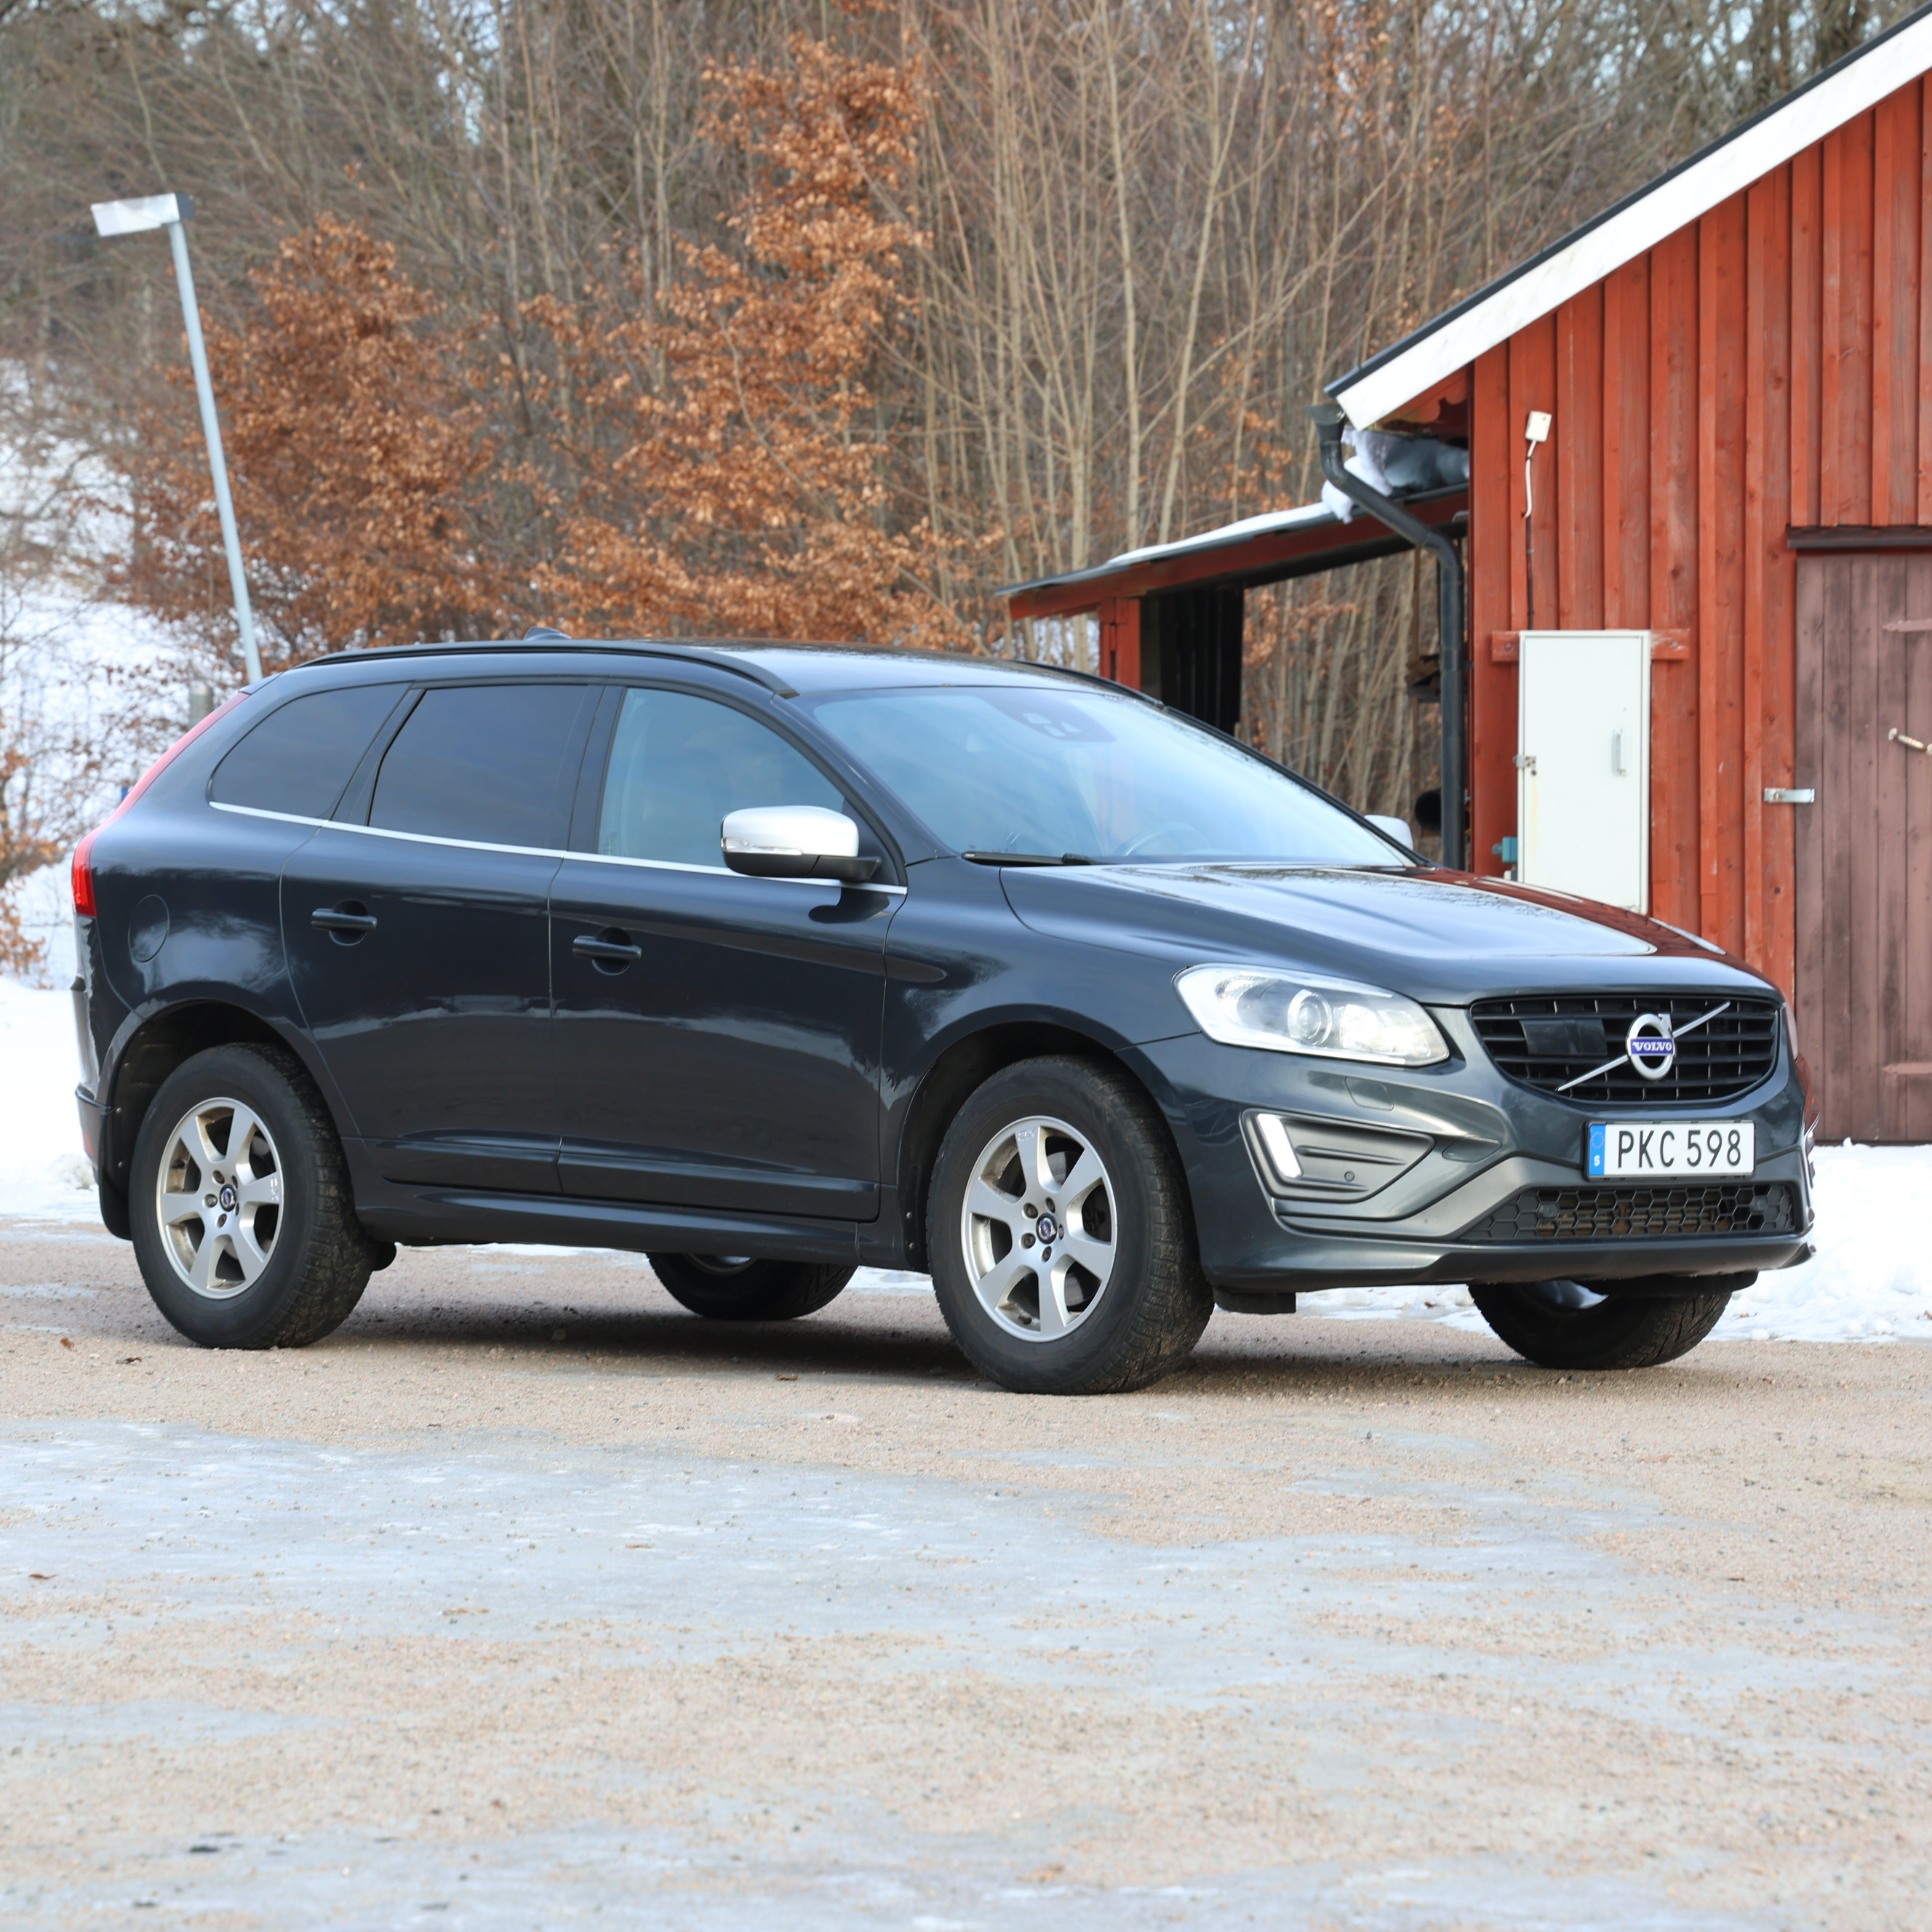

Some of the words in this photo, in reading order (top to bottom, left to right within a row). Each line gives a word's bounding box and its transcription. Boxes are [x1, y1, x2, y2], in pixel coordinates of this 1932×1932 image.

[1632, 1041, 1672, 1052] VOLVO
[1617, 1130, 1675, 1168] PKC
[1686, 1129, 1741, 1167] 598
[1594, 1154, 1600, 1167] S
